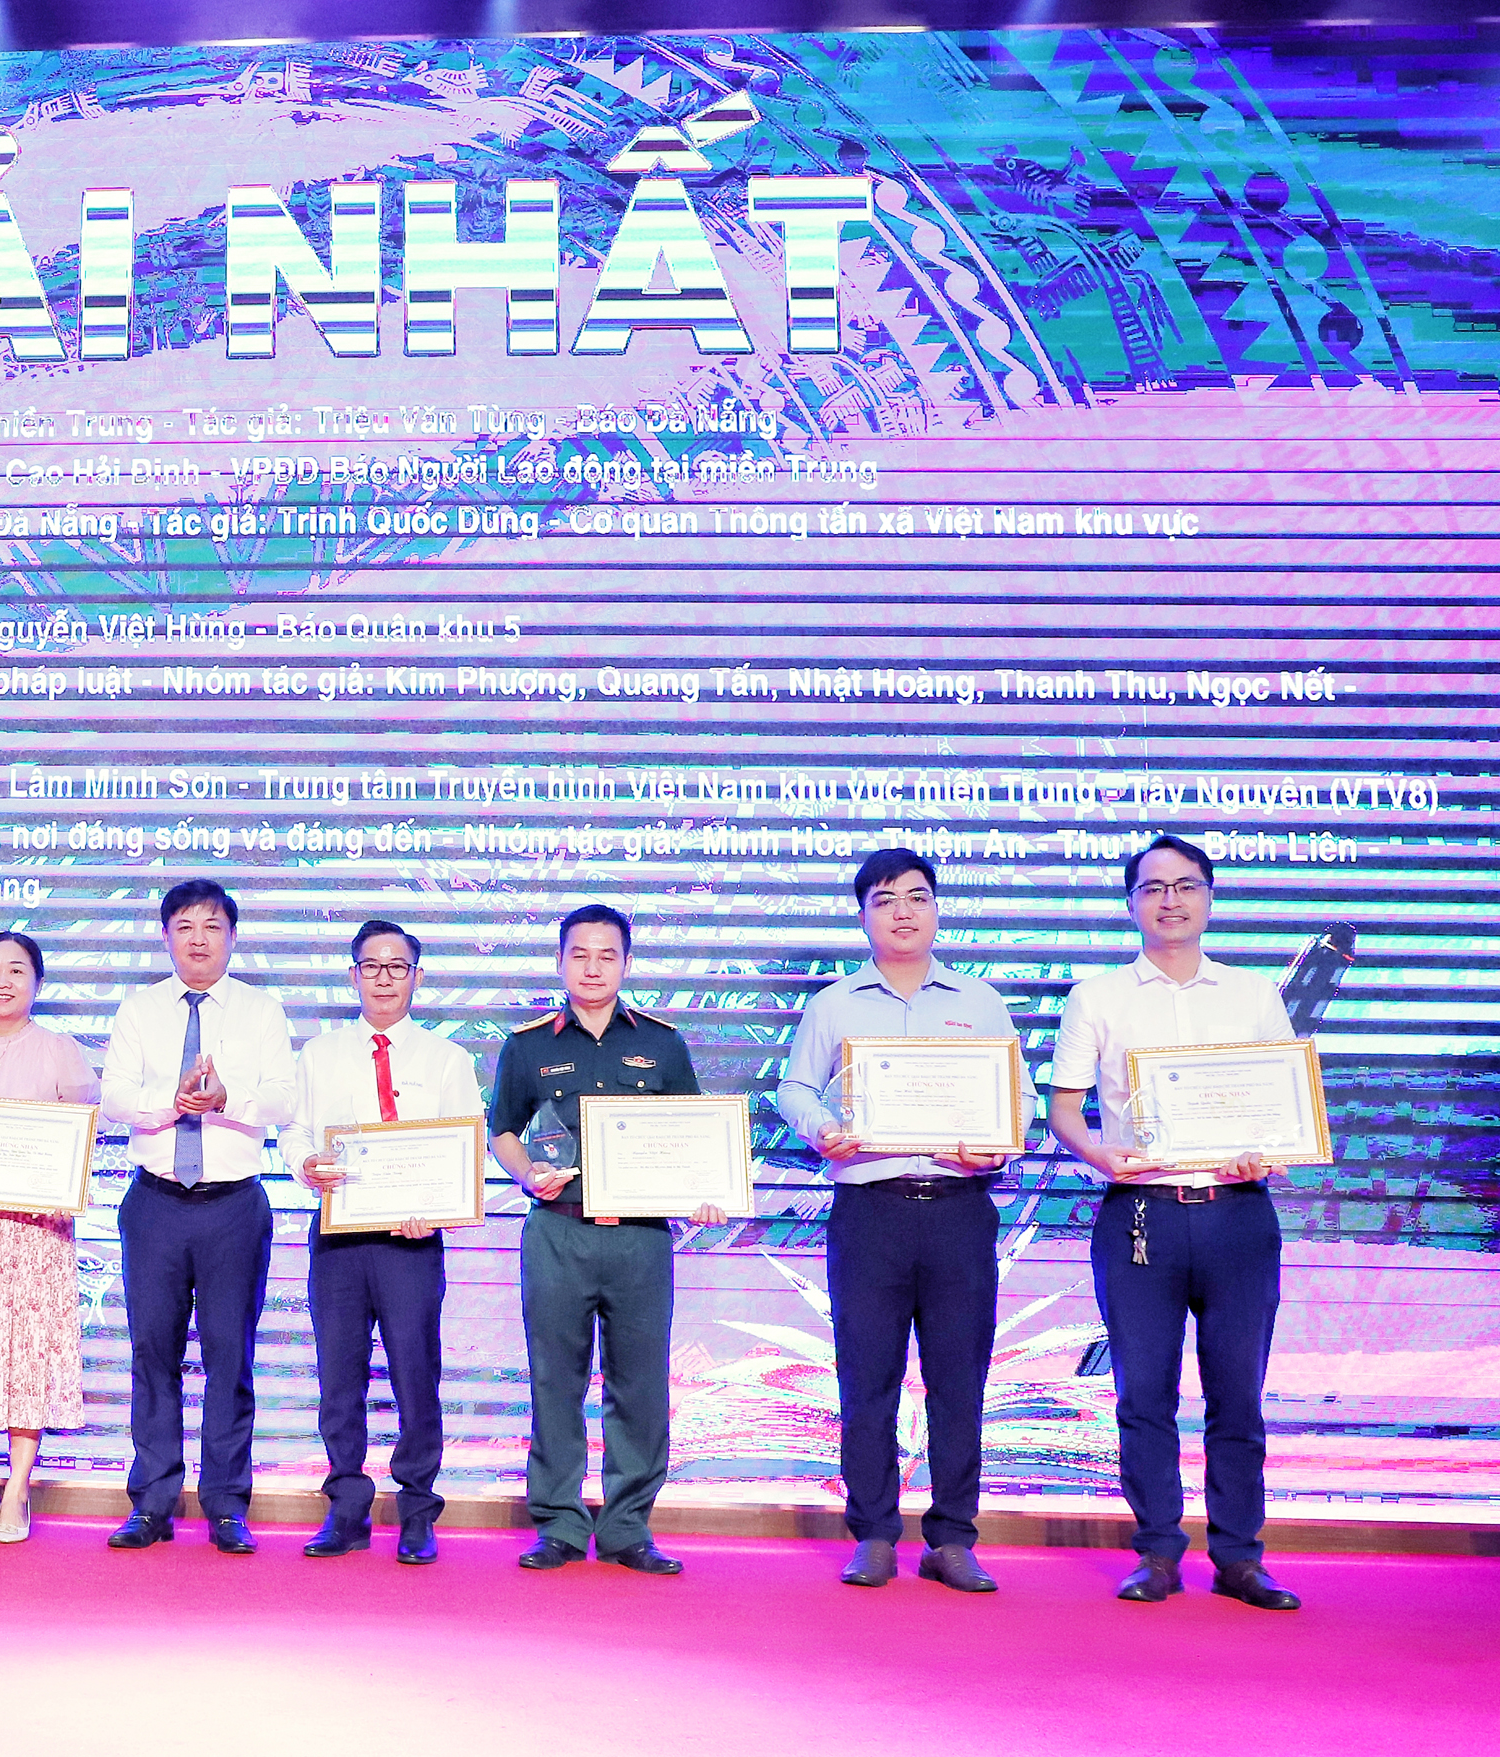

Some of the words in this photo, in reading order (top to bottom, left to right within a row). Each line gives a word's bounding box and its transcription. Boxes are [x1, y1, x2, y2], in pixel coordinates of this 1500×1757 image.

[226, 92, 872, 361] NHẤT
[40, 502, 117, 542] Nẵng
[99, 614, 156, 648] Việt
[166, 614, 246, 650] Hùng
[276, 613, 336, 642] Báo
[346, 614, 425, 642] Quân
[439, 614, 493, 642] khu
[504, 615, 521, 642] 5
[78, 666, 132, 699] luật
[164, 666, 250, 694] Nhóm
[262, 666, 308, 694] tác
[318, 662, 373, 702] giả:
[386, 667, 444, 695] Kim
[458, 667, 586, 702] Phượng,
[598, 666, 700, 703] Quang
[710, 662, 777, 702] Tấn,
[789, 668, 862, 702] Nhật
[873, 668, 985, 705] Hoàng,
[995, 669, 1095, 699] Thanh
[1106, 671, 1176, 705] Thu,
[1188, 671, 1269, 707] Ngọc
[1281, 667, 1335, 700] Nết
[10, 768, 72, 798] Lâm
[85, 769, 158, 799] Minh
[168, 769, 228, 799] Sơn
[259, 769, 350, 805] Trung
[361, 769, 417, 799] tâm
[428, 766, 536, 806] Truyền
[548, 769, 615, 799] hình
[698, 772, 766, 800] Nam
[780, 773, 838, 800] khu
[1000, 775, 1098, 812] Trung
[1128, 777, 1186, 814] Tây
[1197, 777, 1318, 815] Nguyên
[1330, 777, 1439, 816] (VTV8)
[12, 820, 58, 850] nơi
[68, 819, 143, 856] đáng
[154, 817, 230, 858] sống
[240, 821, 275, 851] và
[286, 821, 364, 858] đáng
[374, 818, 431, 852] đến
[465, 822, 558, 854] Nhóm
[568, 822, 615, 854] tác
[702, 824, 779, 855] Minh
[791, 823, 852, 857] Hòa
[883, 826, 971, 862] Thiện
[984, 829, 1026, 858] An
[1058, 829, 1121, 859] Thu
[1203, 829, 1277, 861] Bích
[1288, 830, 1357, 862] Liên
